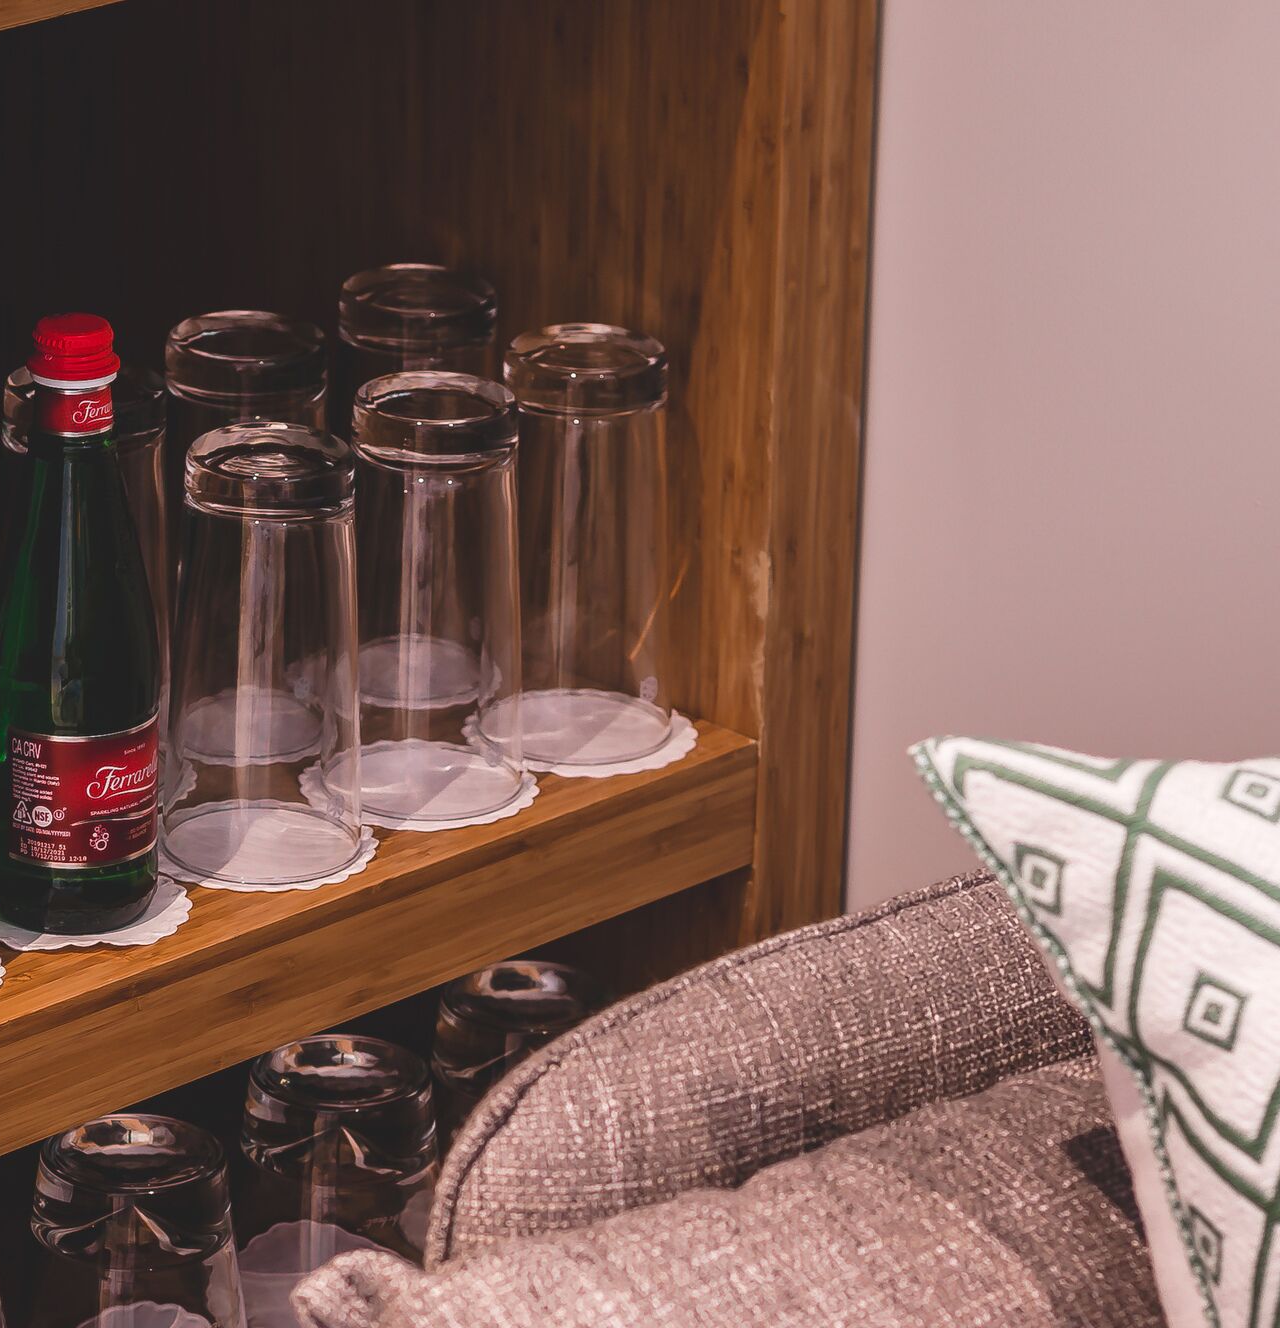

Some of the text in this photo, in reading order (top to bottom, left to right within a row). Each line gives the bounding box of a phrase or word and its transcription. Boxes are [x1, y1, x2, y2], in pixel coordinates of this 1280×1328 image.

[12, 738, 41, 759] CA CRV
[86, 749, 158, 799] Ferrarell
[90, 807, 119, 817] SPARKLING
